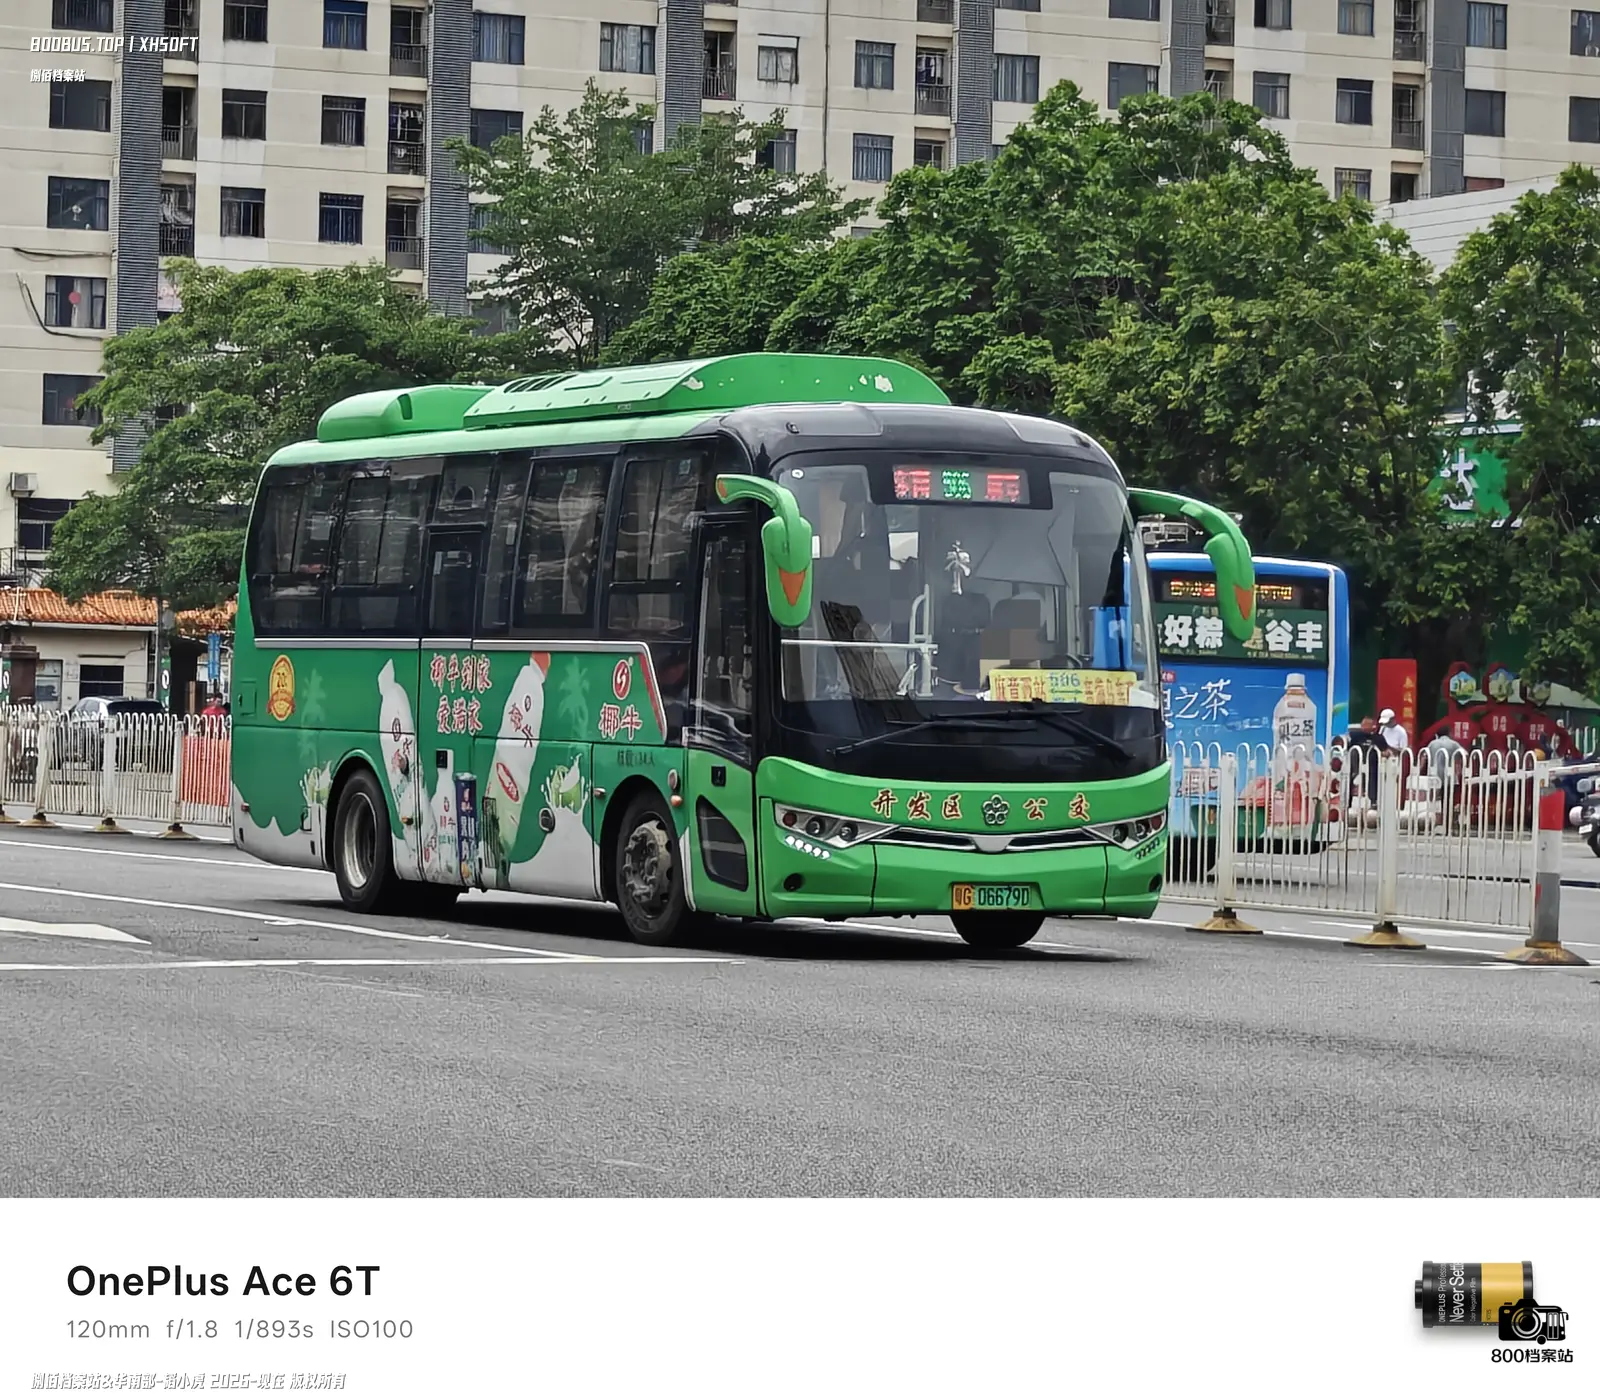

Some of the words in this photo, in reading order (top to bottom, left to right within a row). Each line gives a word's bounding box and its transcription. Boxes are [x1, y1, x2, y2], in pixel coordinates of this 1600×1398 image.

[437, 695, 484, 737] 爱满家
[598, 702, 643, 741] 椰牛
[871, 789, 963, 821] 开发区
[1023, 793, 1090, 822] 公交
